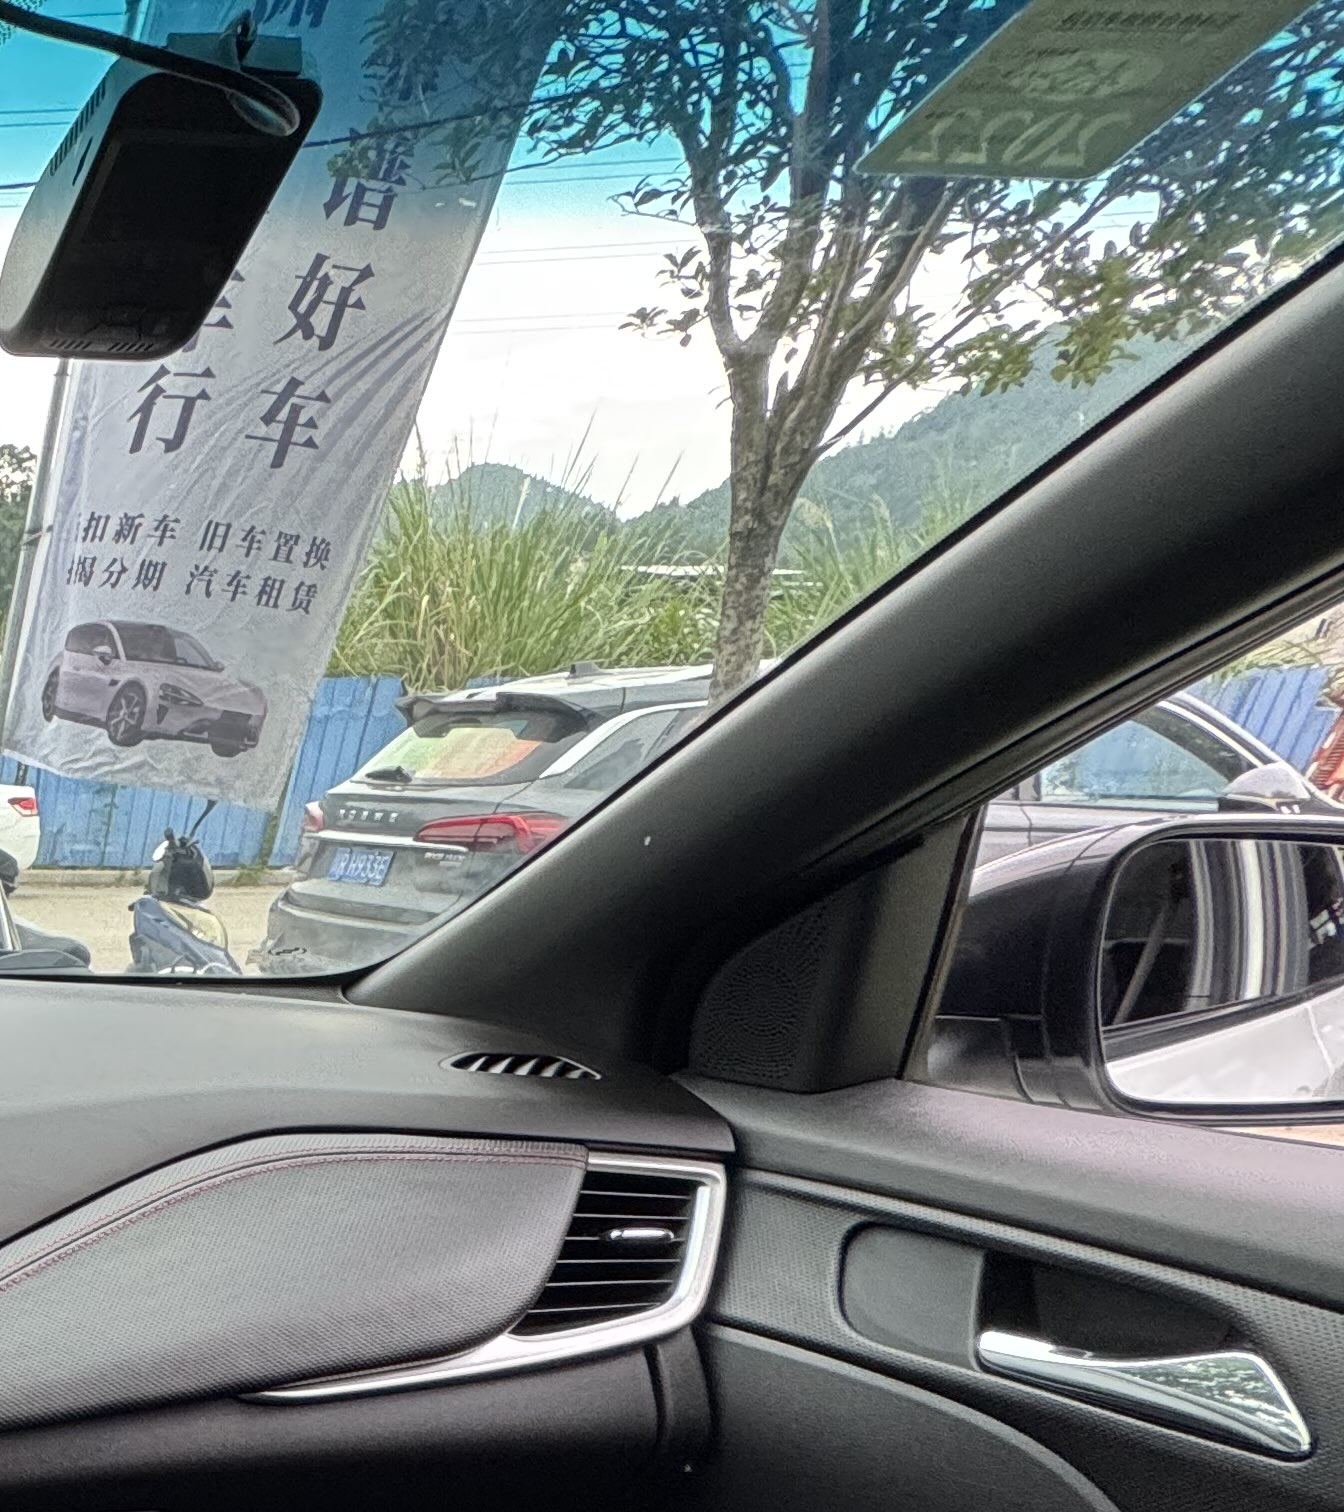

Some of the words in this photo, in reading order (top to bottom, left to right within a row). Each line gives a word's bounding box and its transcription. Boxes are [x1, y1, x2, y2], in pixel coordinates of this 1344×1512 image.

[75, 511, 180, 547] 扣新车
[199, 519, 333, 572] 旧车置换
[185, 563, 319, 615] 汽车租赁
